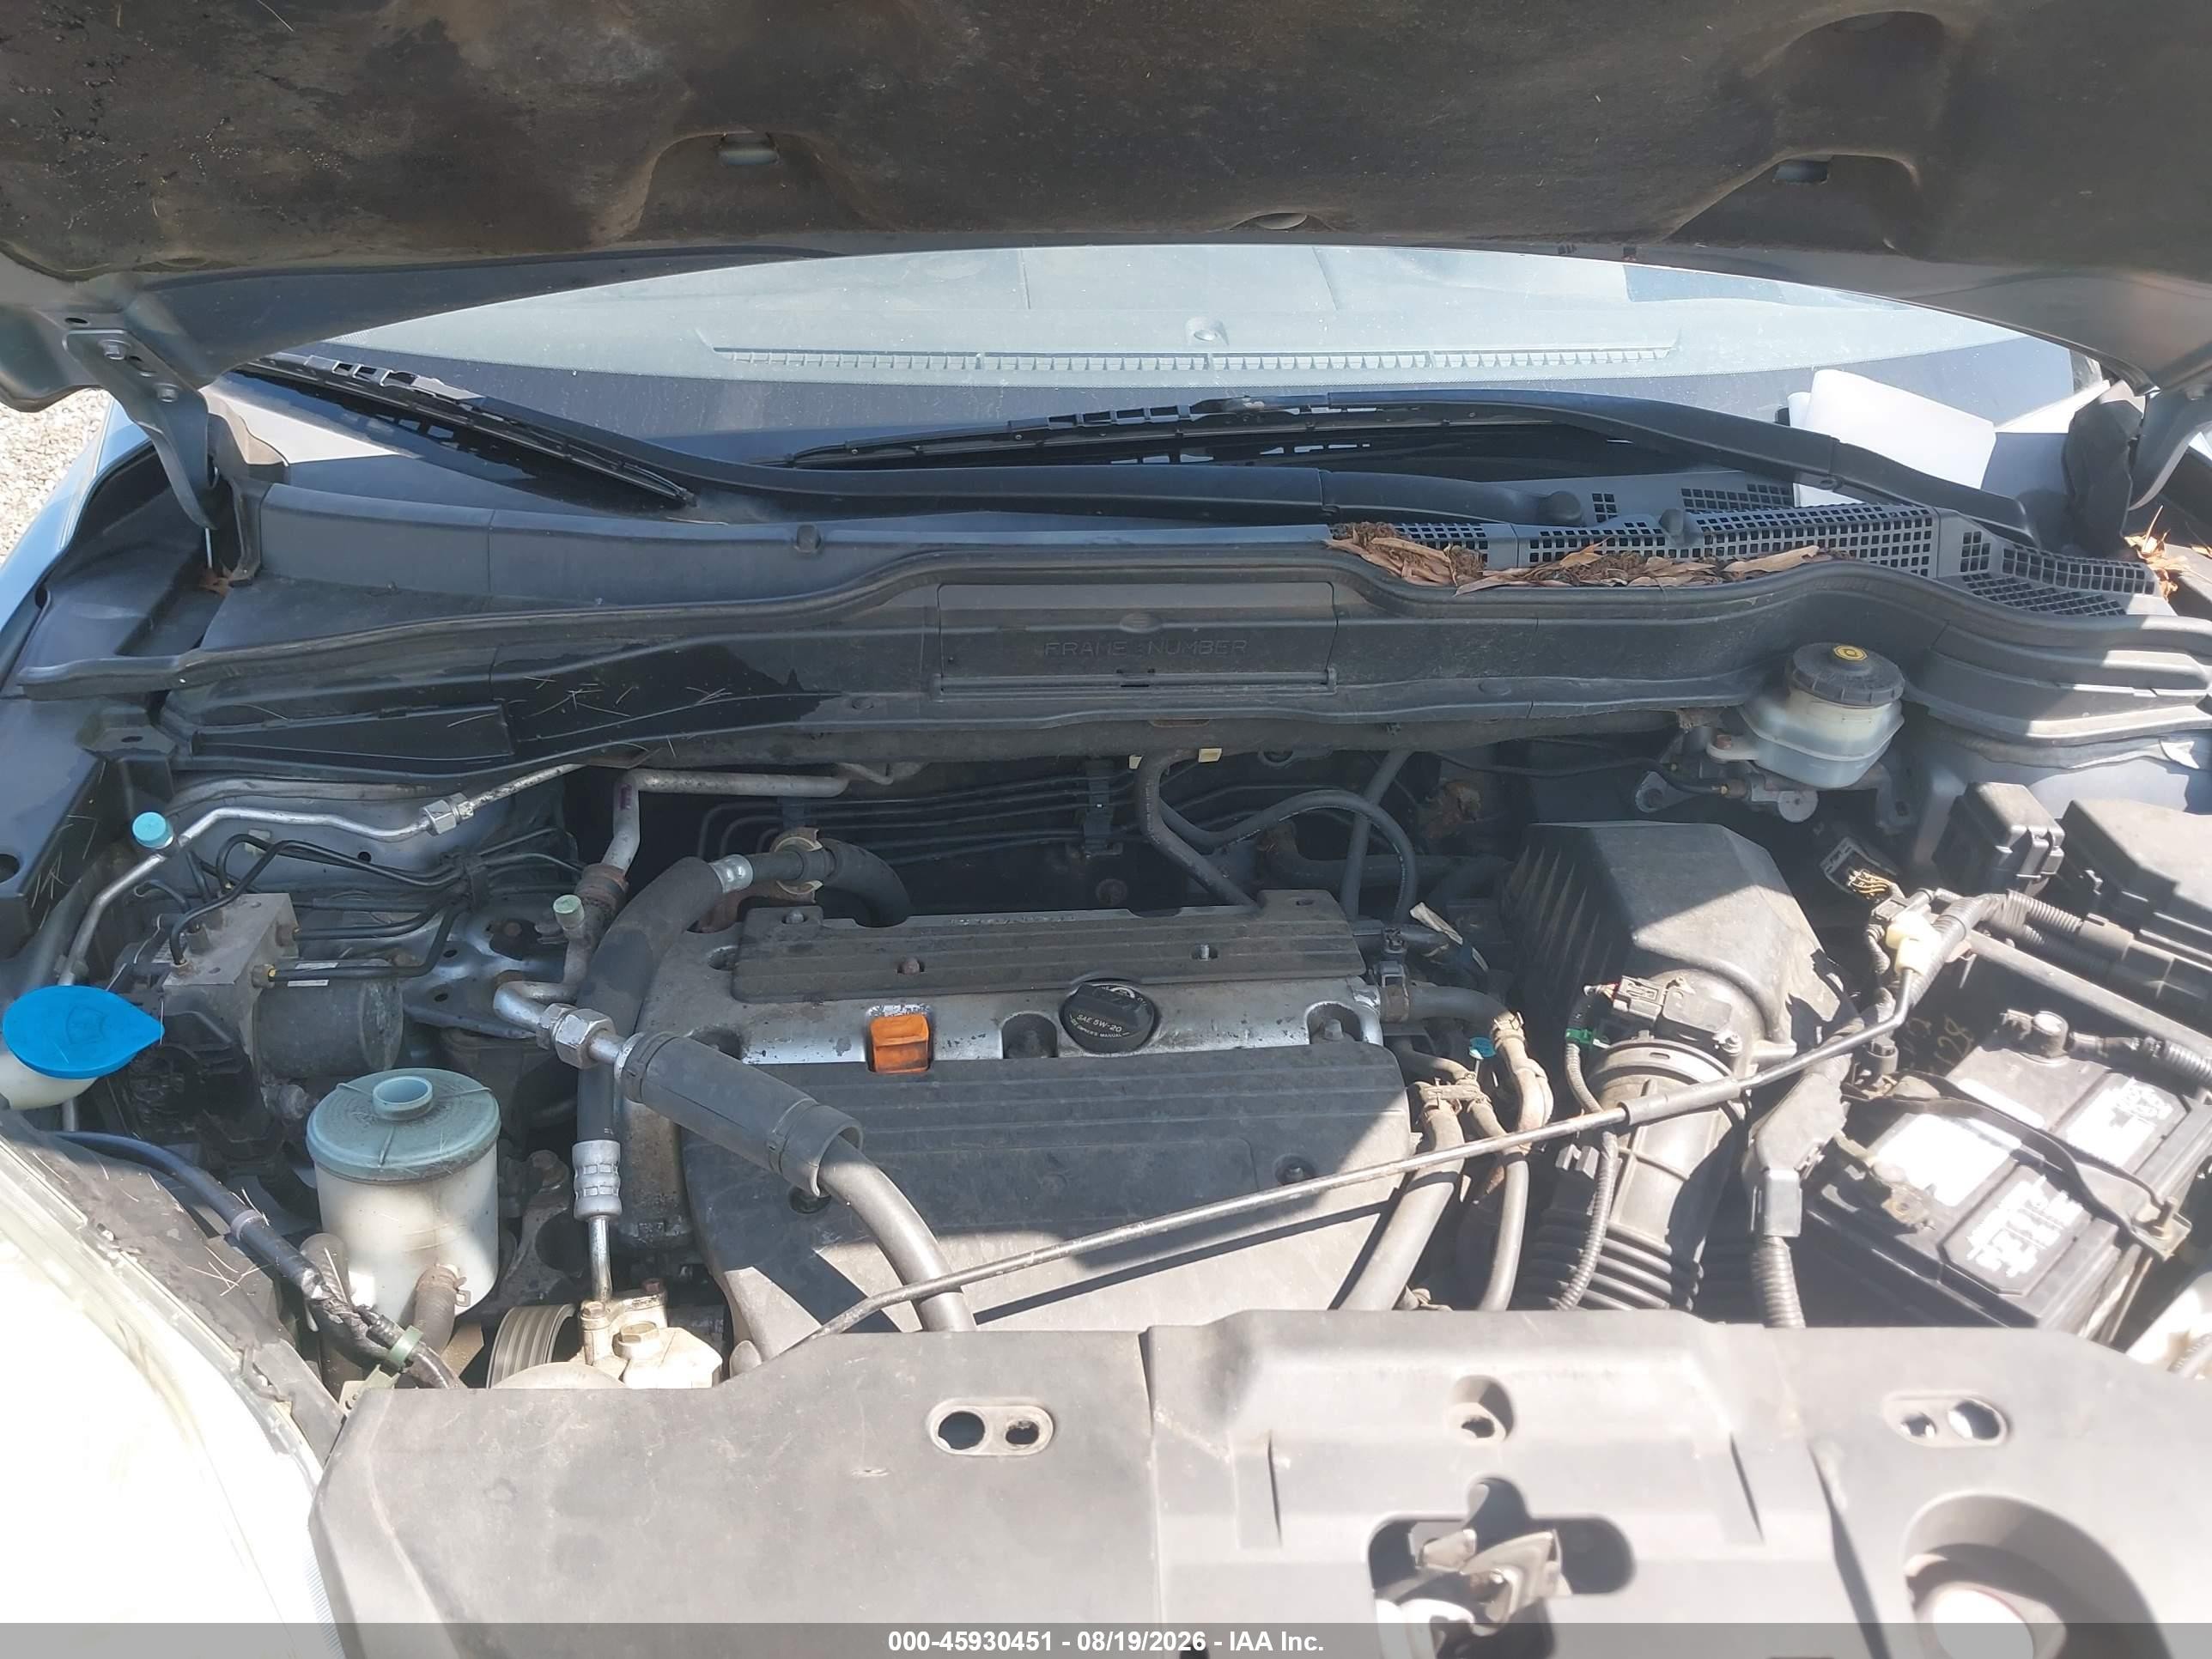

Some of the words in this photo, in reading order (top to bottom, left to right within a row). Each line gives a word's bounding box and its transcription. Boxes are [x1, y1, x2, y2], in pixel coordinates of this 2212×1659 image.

[1044, 641, 1127, 656] FRAME
[1147, 640, 1247, 655] NUMBER
[1077, 1014, 1093, 1024] SAE
[1093, 1019, 1122, 1032] 5W-20
